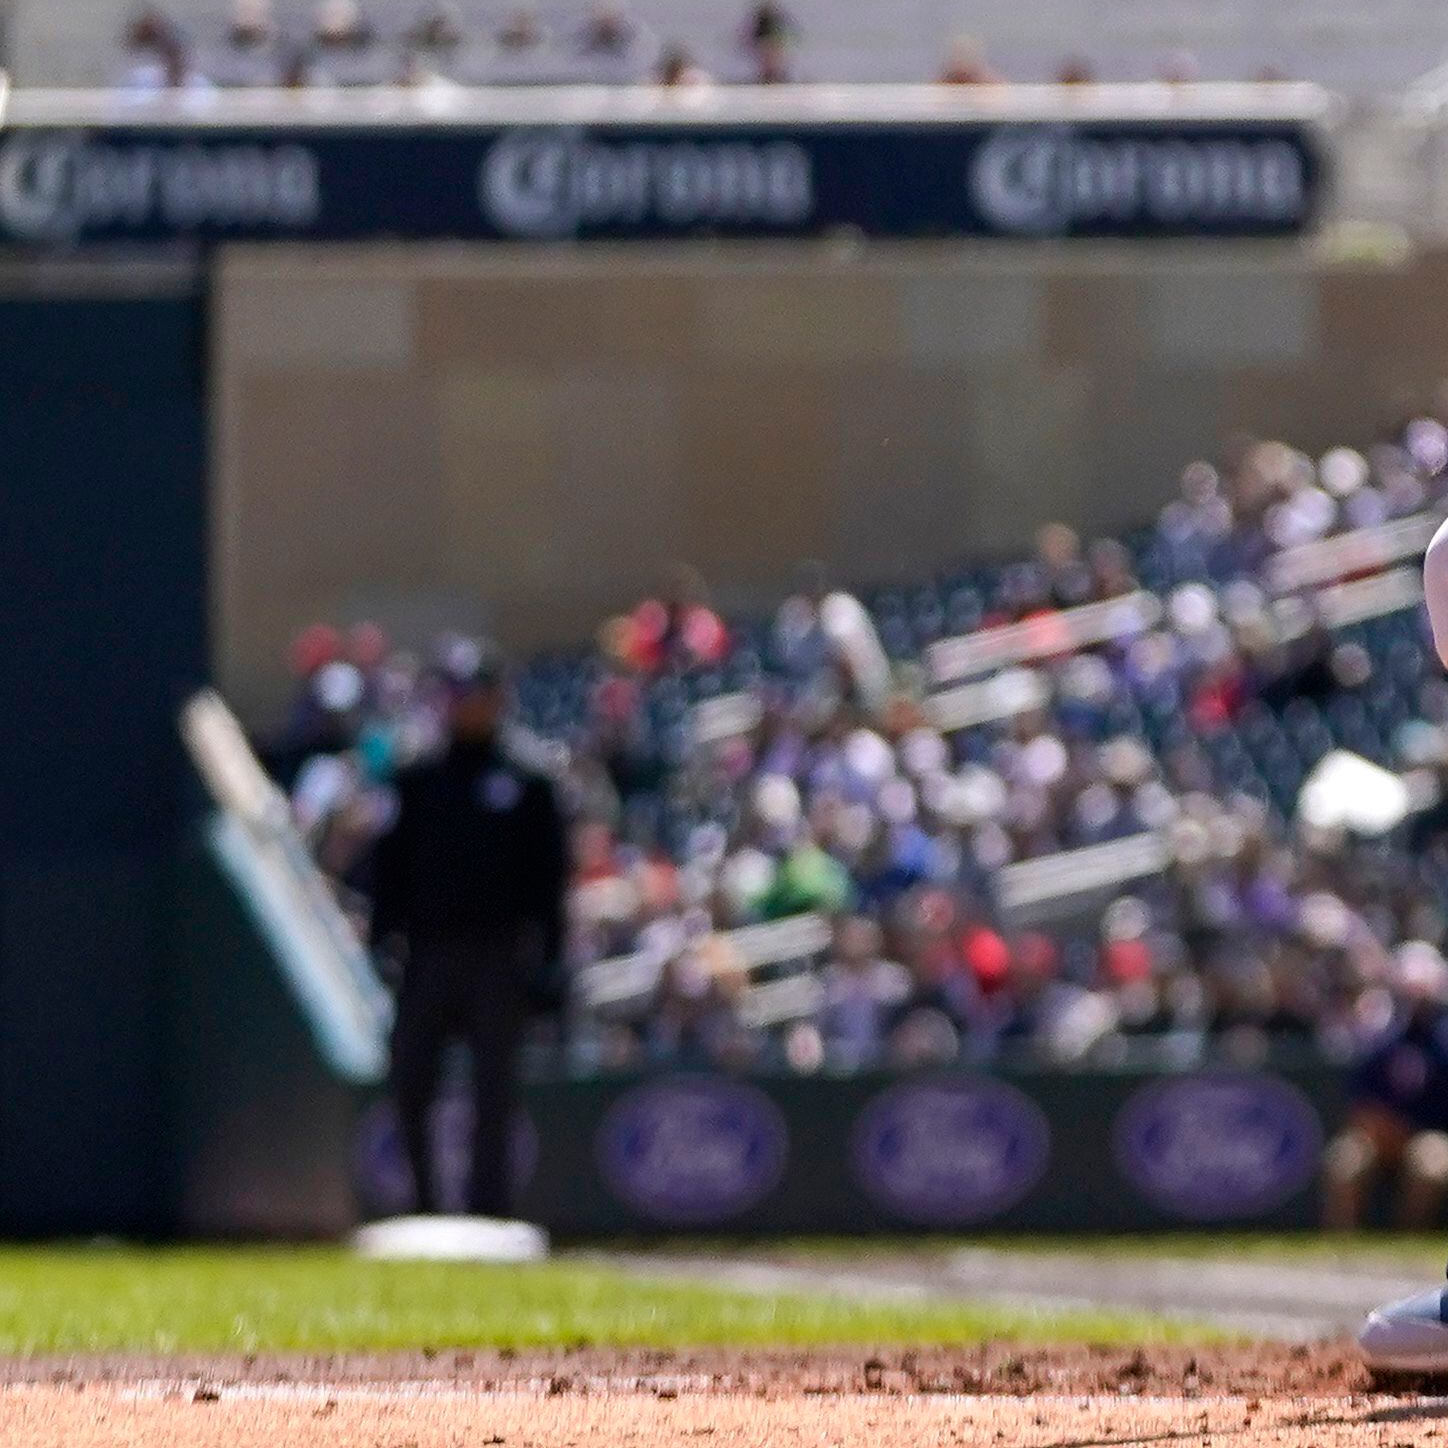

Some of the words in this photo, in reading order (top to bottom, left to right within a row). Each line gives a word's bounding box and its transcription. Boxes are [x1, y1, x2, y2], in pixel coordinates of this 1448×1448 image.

[0, 134, 319, 234] Corona
[480, 128, 811, 234] Corona
[973, 123, 1301, 234] Corona
